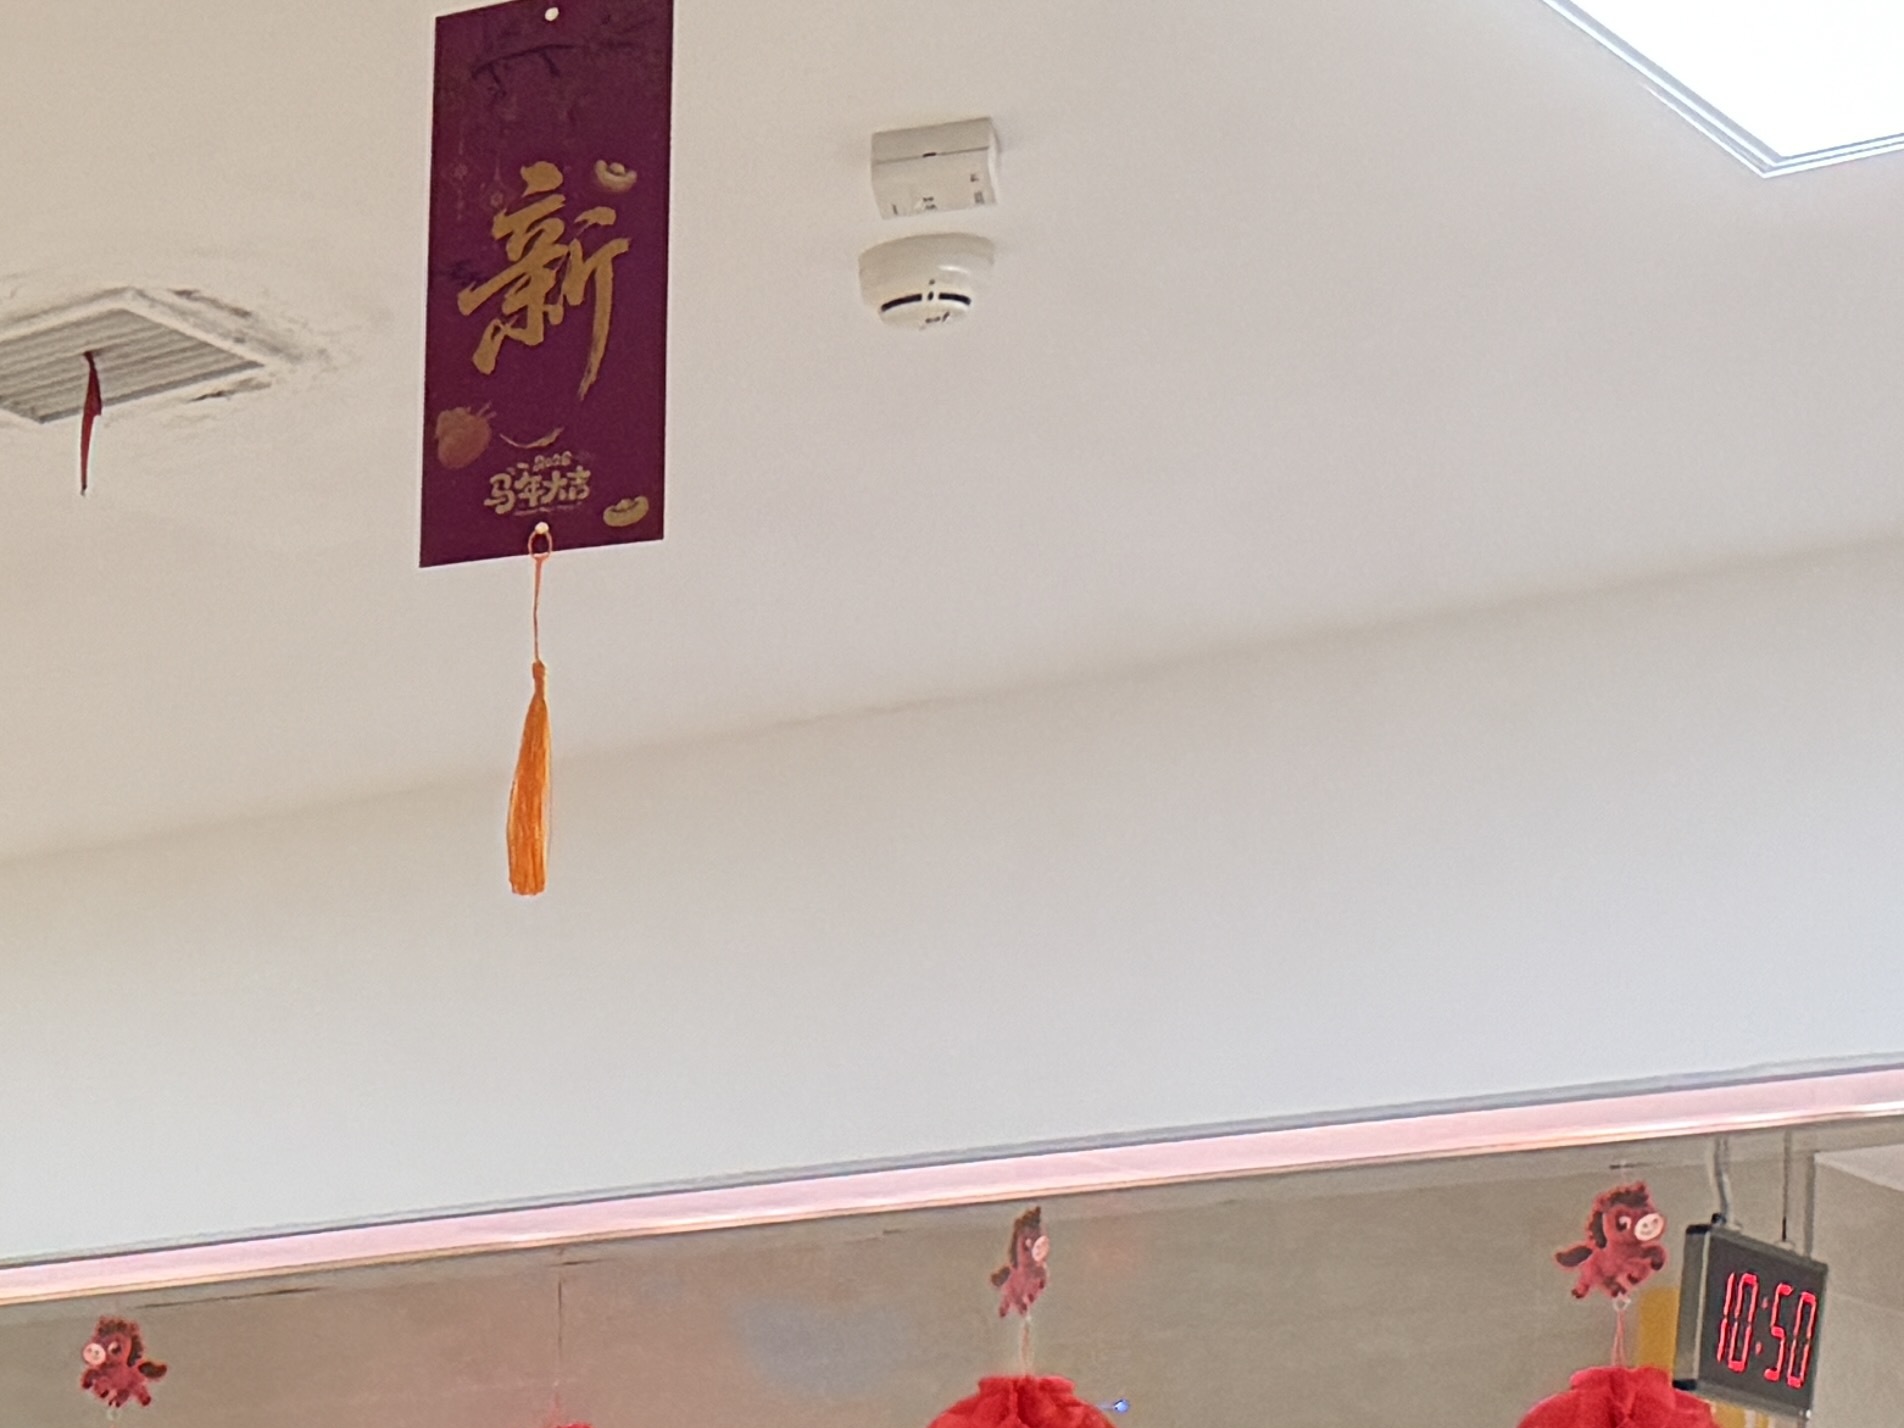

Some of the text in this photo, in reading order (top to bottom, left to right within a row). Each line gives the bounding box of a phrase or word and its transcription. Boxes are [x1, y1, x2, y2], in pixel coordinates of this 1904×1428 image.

[458, 160, 631, 401] 新
[483, 464, 592, 515] 马年大吉
[1716, 1272, 1817, 1389] 10:50
